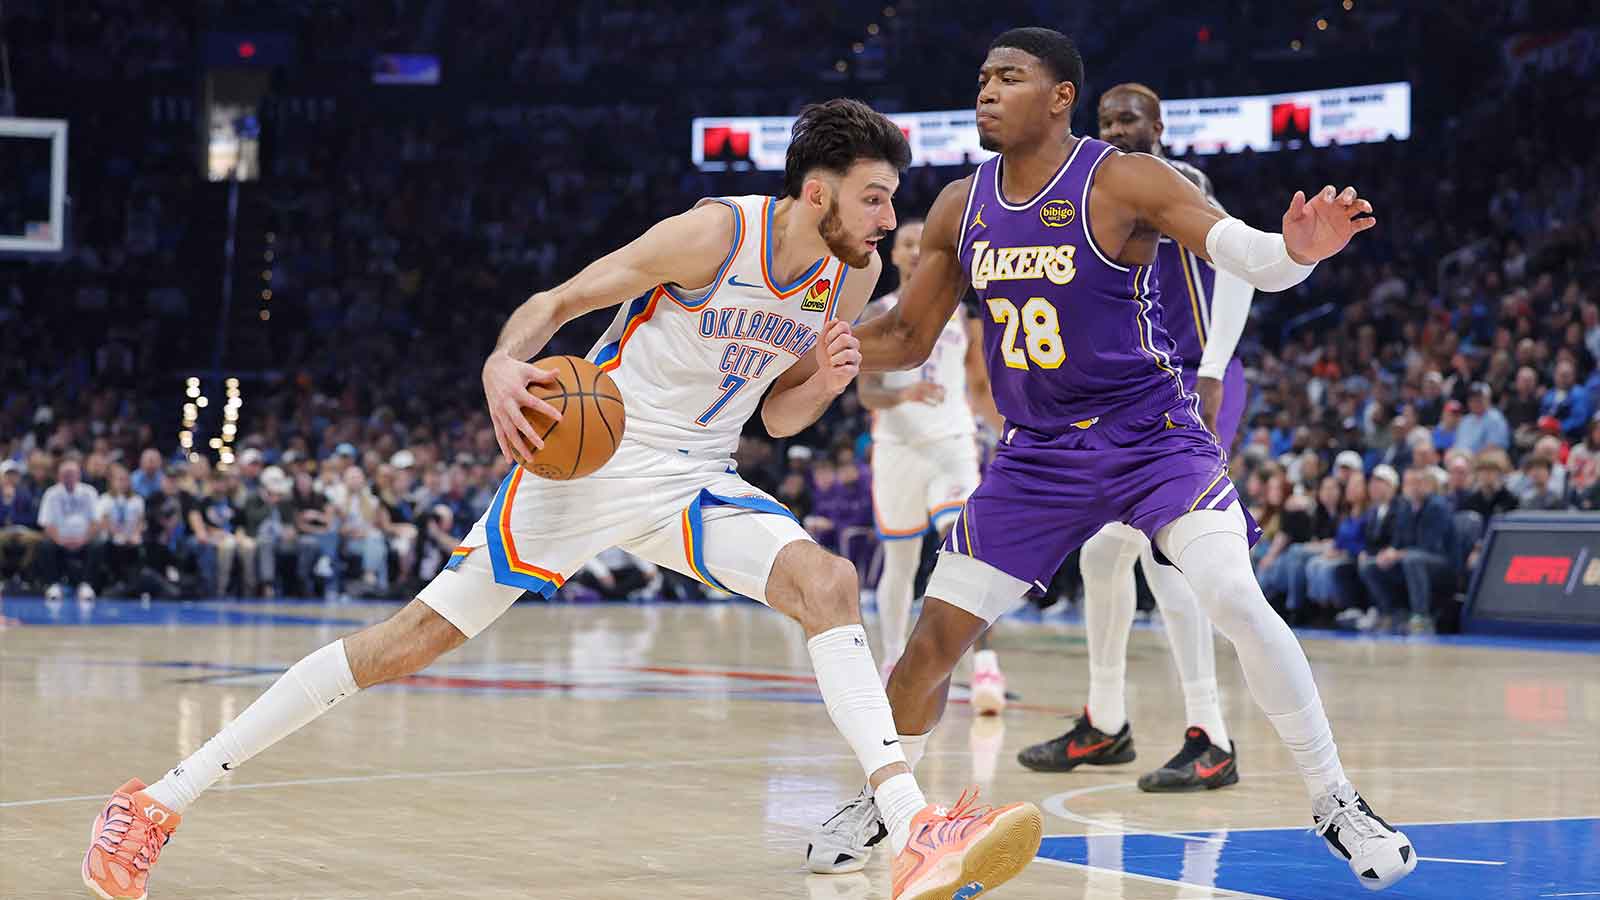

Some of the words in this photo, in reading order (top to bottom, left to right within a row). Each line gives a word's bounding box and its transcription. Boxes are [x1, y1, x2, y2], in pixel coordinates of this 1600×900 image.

[1043, 206, 1073, 220] bibigo
[972, 240, 1077, 289] LAKERS
[699, 307, 819, 358] OKLAHOMA
[986, 297, 1066, 370] 28
[719, 342, 778, 379] CITY
[695, 373, 750, 427] 7
[1504, 555, 1572, 585] ESPN
